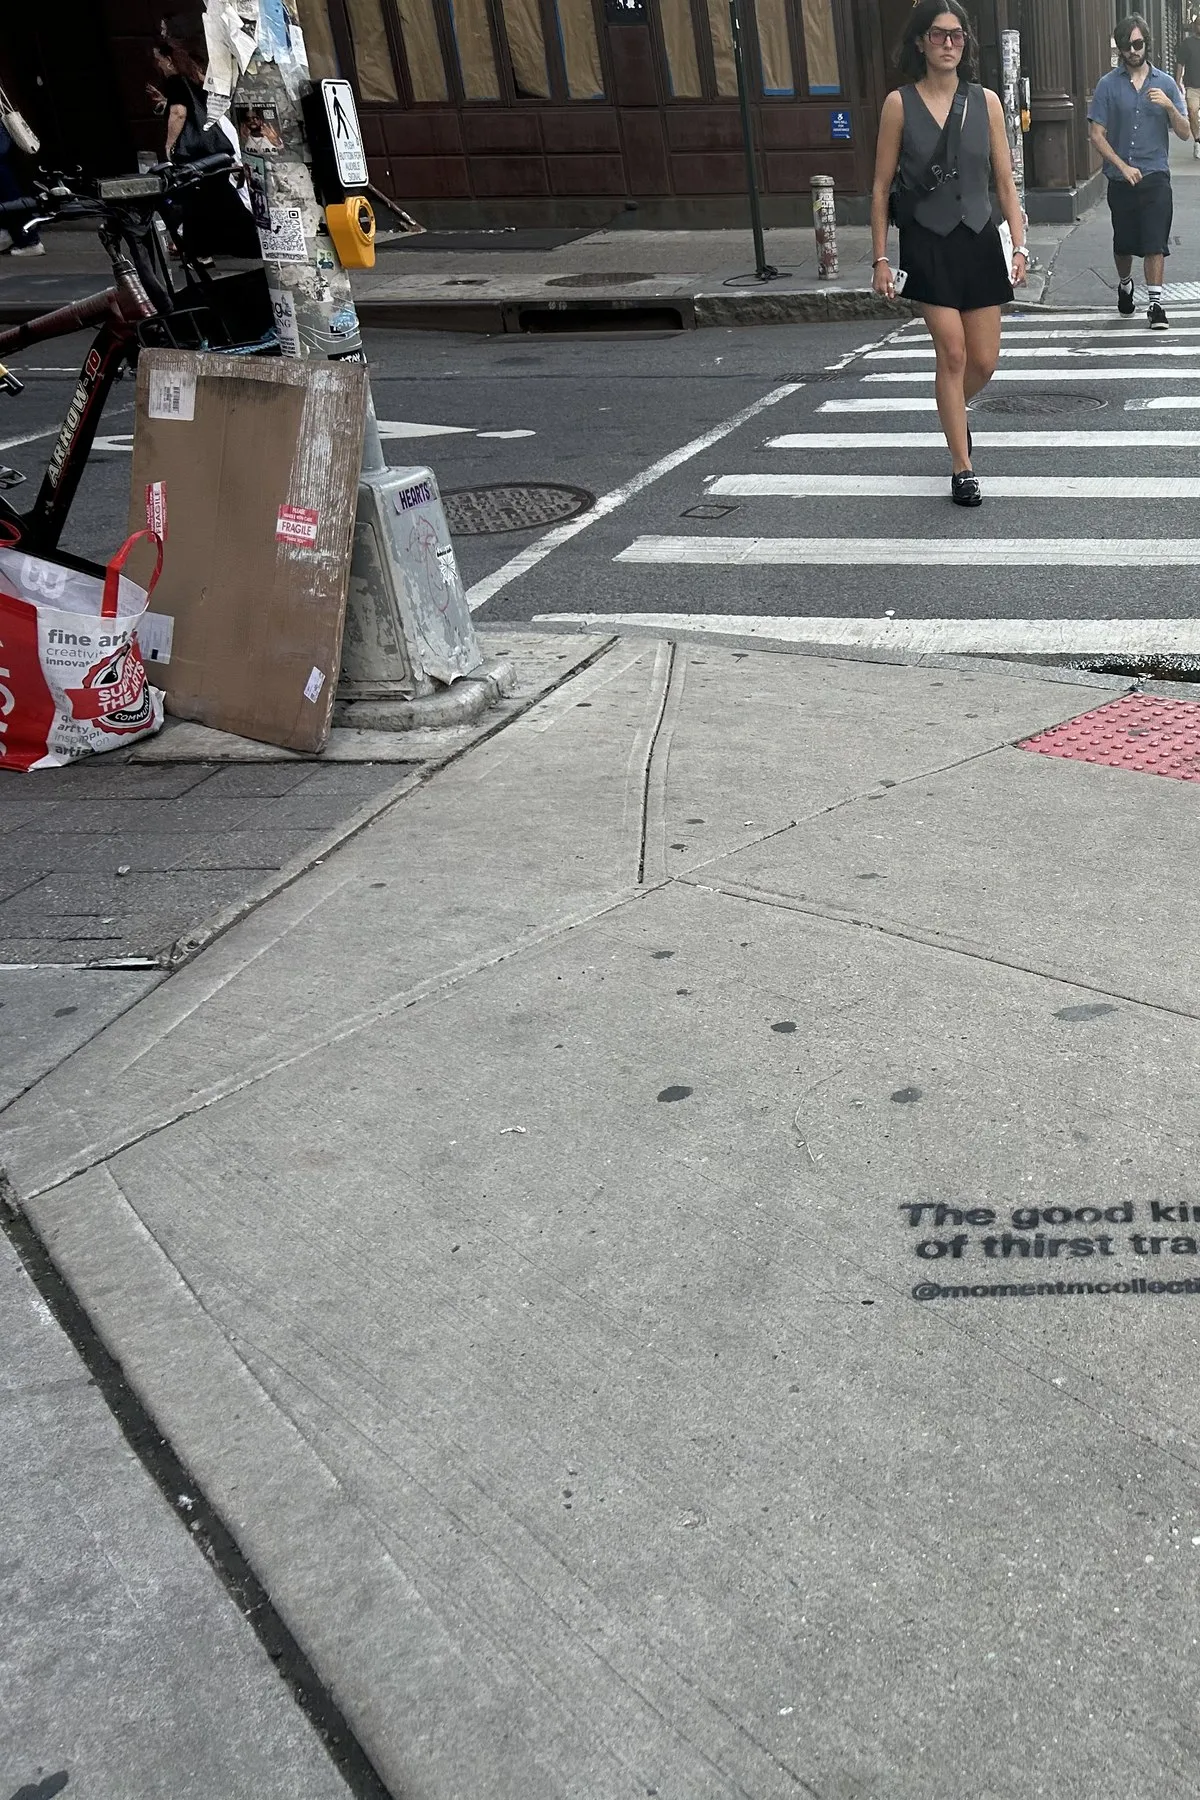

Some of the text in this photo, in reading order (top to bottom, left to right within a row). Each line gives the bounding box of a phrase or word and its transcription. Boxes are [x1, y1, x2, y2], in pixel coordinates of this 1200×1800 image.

[398, 482, 431, 510] HEARTS
[154, 492, 162, 534] FRAGILE
[281, 521, 312, 536] FRAGILE
[48, 629, 92, 647] fine
[98, 653, 138, 700] SUPPORT
[98, 691, 134, 712] THE
[131, 660, 145, 697] ARTS
[115, 687, 149, 721] COMMUNITY
[899, 1201, 996, 1228] The
[1010, 1200, 1134, 1231] good
[915, 1233, 969, 1260] of
[980, 1232, 1115, 1259] thirst
